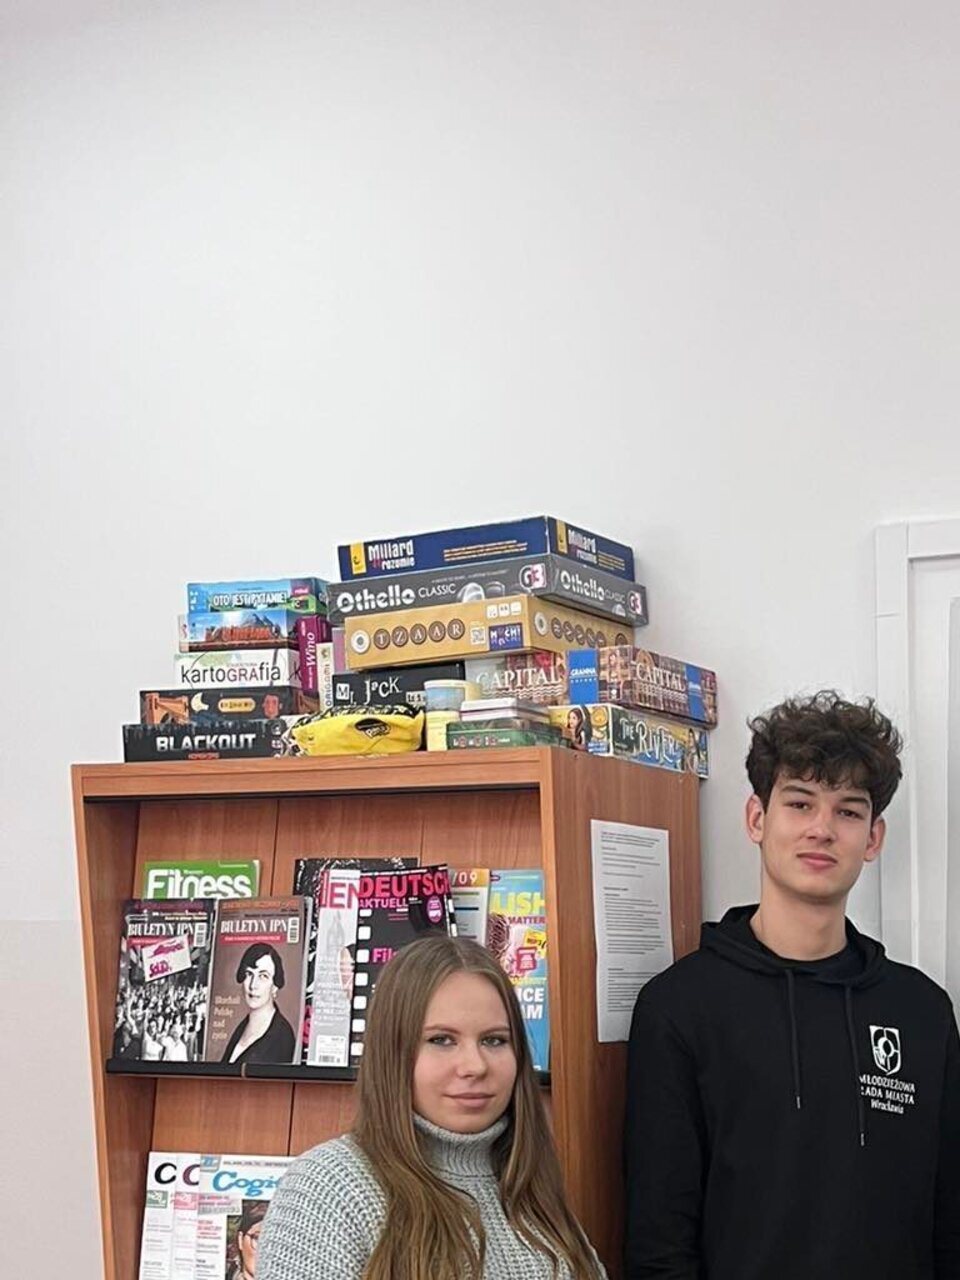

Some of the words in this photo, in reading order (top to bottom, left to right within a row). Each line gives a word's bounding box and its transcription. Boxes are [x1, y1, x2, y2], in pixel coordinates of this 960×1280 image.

[337, 584, 415, 613] Othello
[418, 583, 456, 598] CLASSIC
[561, 570, 605, 601] Othello
[213, 594, 229, 607] OTO
[376, 619, 463, 647] TZAAR
[306, 631, 316, 667] Wino
[181, 661, 281, 684] kartoGRAfia
[476, 665, 562, 690] CAPITAL
[636, 662, 686, 691] CAPITAL
[156, 733, 256, 752] BLACKOUT
[147, 868, 252, 901] Fitness
[128, 923, 175, 936] BIULETYN
[221, 920, 268, 933] BIULETYN
[269, 919, 287, 932] IPN
[885, 1089, 915, 1105] MIASTA
